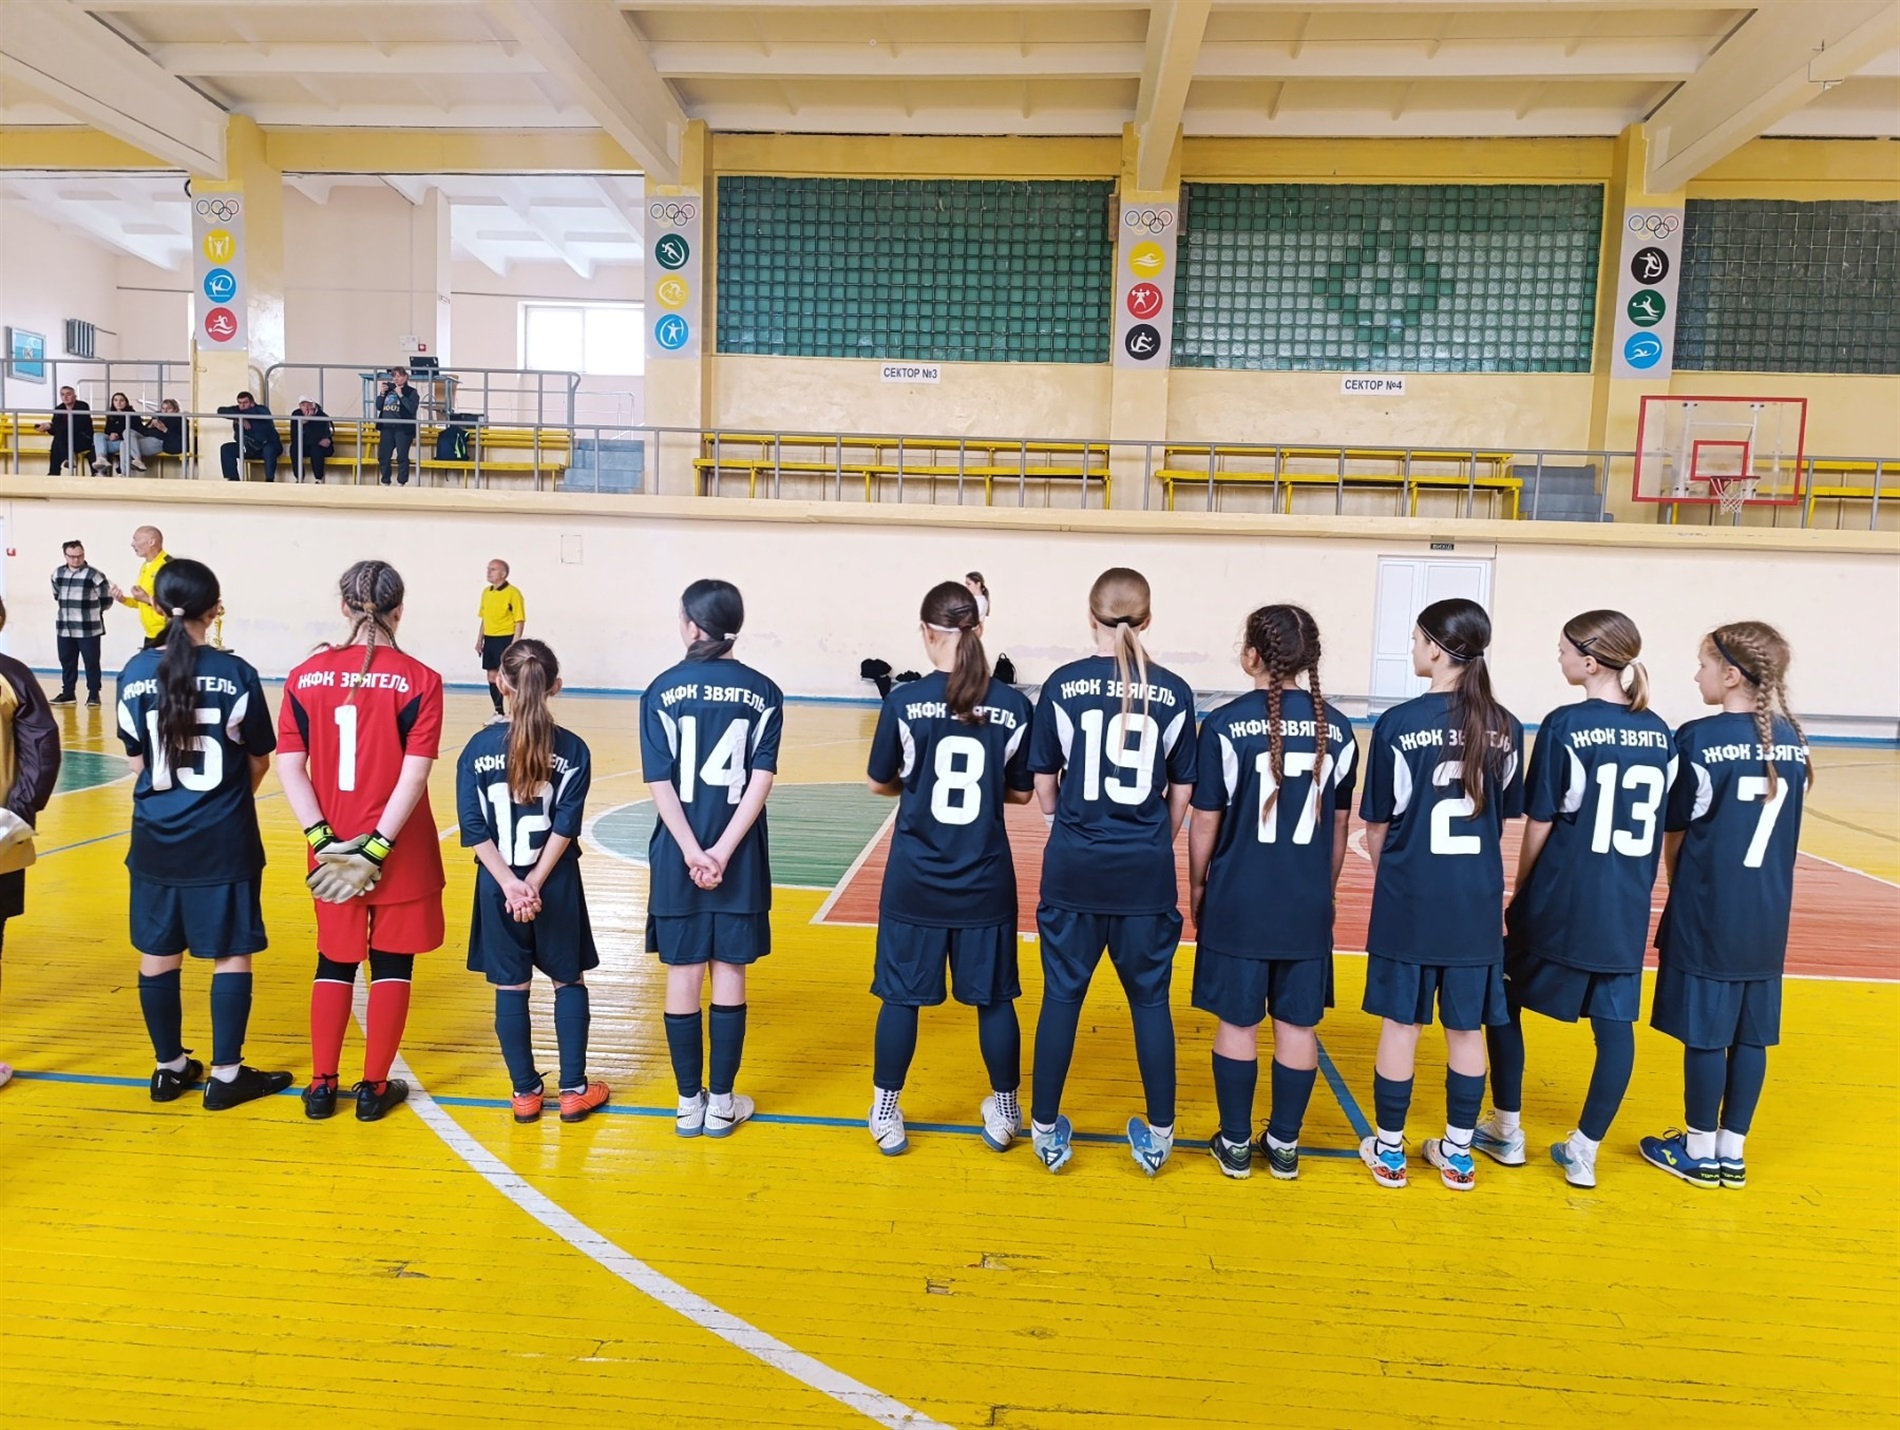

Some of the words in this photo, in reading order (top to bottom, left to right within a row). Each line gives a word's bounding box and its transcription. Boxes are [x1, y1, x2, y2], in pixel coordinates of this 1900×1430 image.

[883, 367, 920, 378] СЕКТОР
[922, 369, 938, 379] №3
[1345, 380, 1383, 390] СЕКТОР
[1386, 381, 1402, 390] №4
[298, 671, 335, 689] ЖФК
[661, 684, 698, 707] ЖФК
[703, 685, 766, 713] ЗВЯГЕЛЬ
[906, 701, 947, 720] ЖФК
[1061, 679, 1101, 699] ЖФК
[146, 707, 223, 792] 15
[334, 704, 357, 792] 1
[677, 715, 750, 805] 14
[930, 735, 985, 825] 8
[1081, 708, 1159, 806] 19
[1399, 729, 1443, 751] ЖФК
[1570, 728, 1616, 748] ЖФК
[1702, 744, 1751, 764] ЖФК
[487, 781, 554, 867] 12
[1255, 751, 1334, 845] 17
[1430, 760, 1484, 855] 2
[1591, 762, 1665, 857] 13
[1736, 776, 1789, 868] 7
